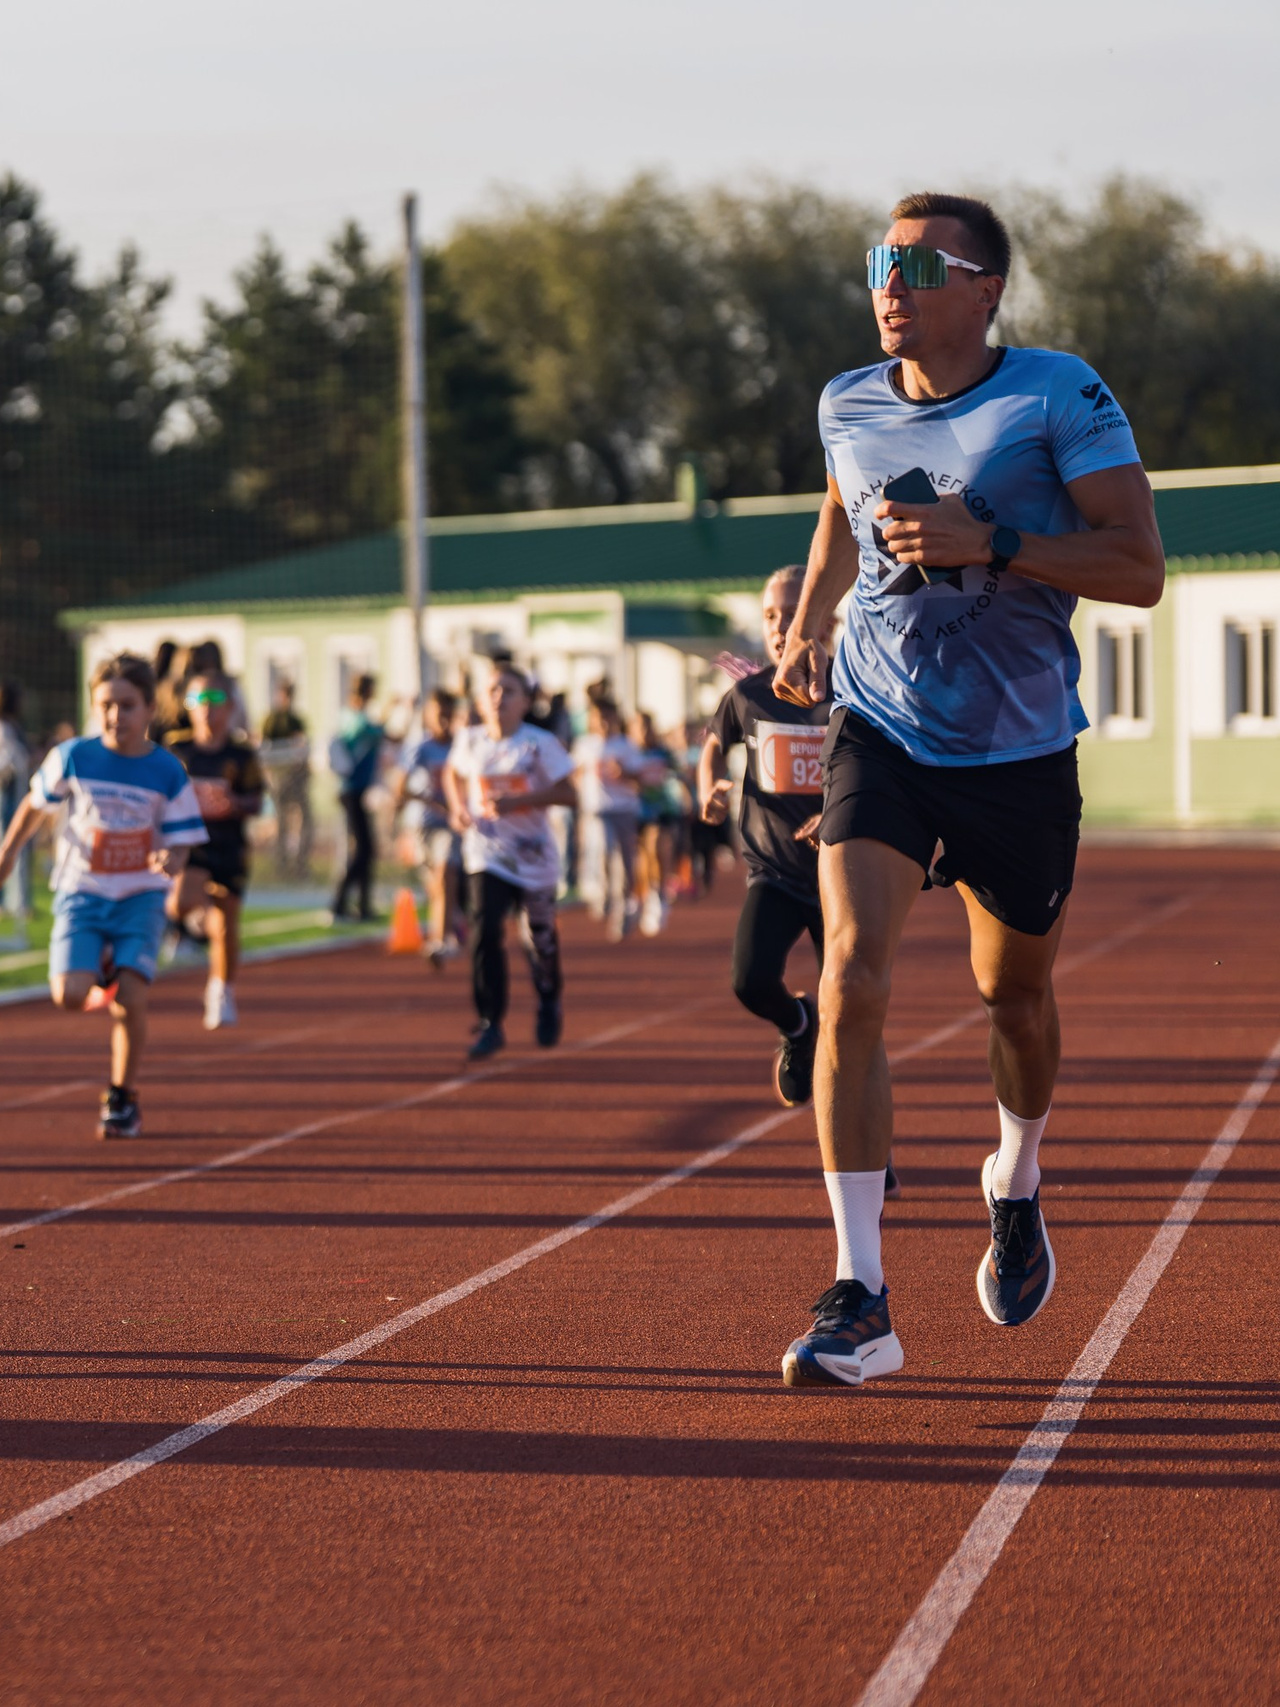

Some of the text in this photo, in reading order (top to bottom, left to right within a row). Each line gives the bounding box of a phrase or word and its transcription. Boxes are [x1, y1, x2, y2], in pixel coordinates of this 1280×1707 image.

[851, 470, 996, 543] ОМАН ЛЕГКОВ
[792, 757, 822, 787] 92
